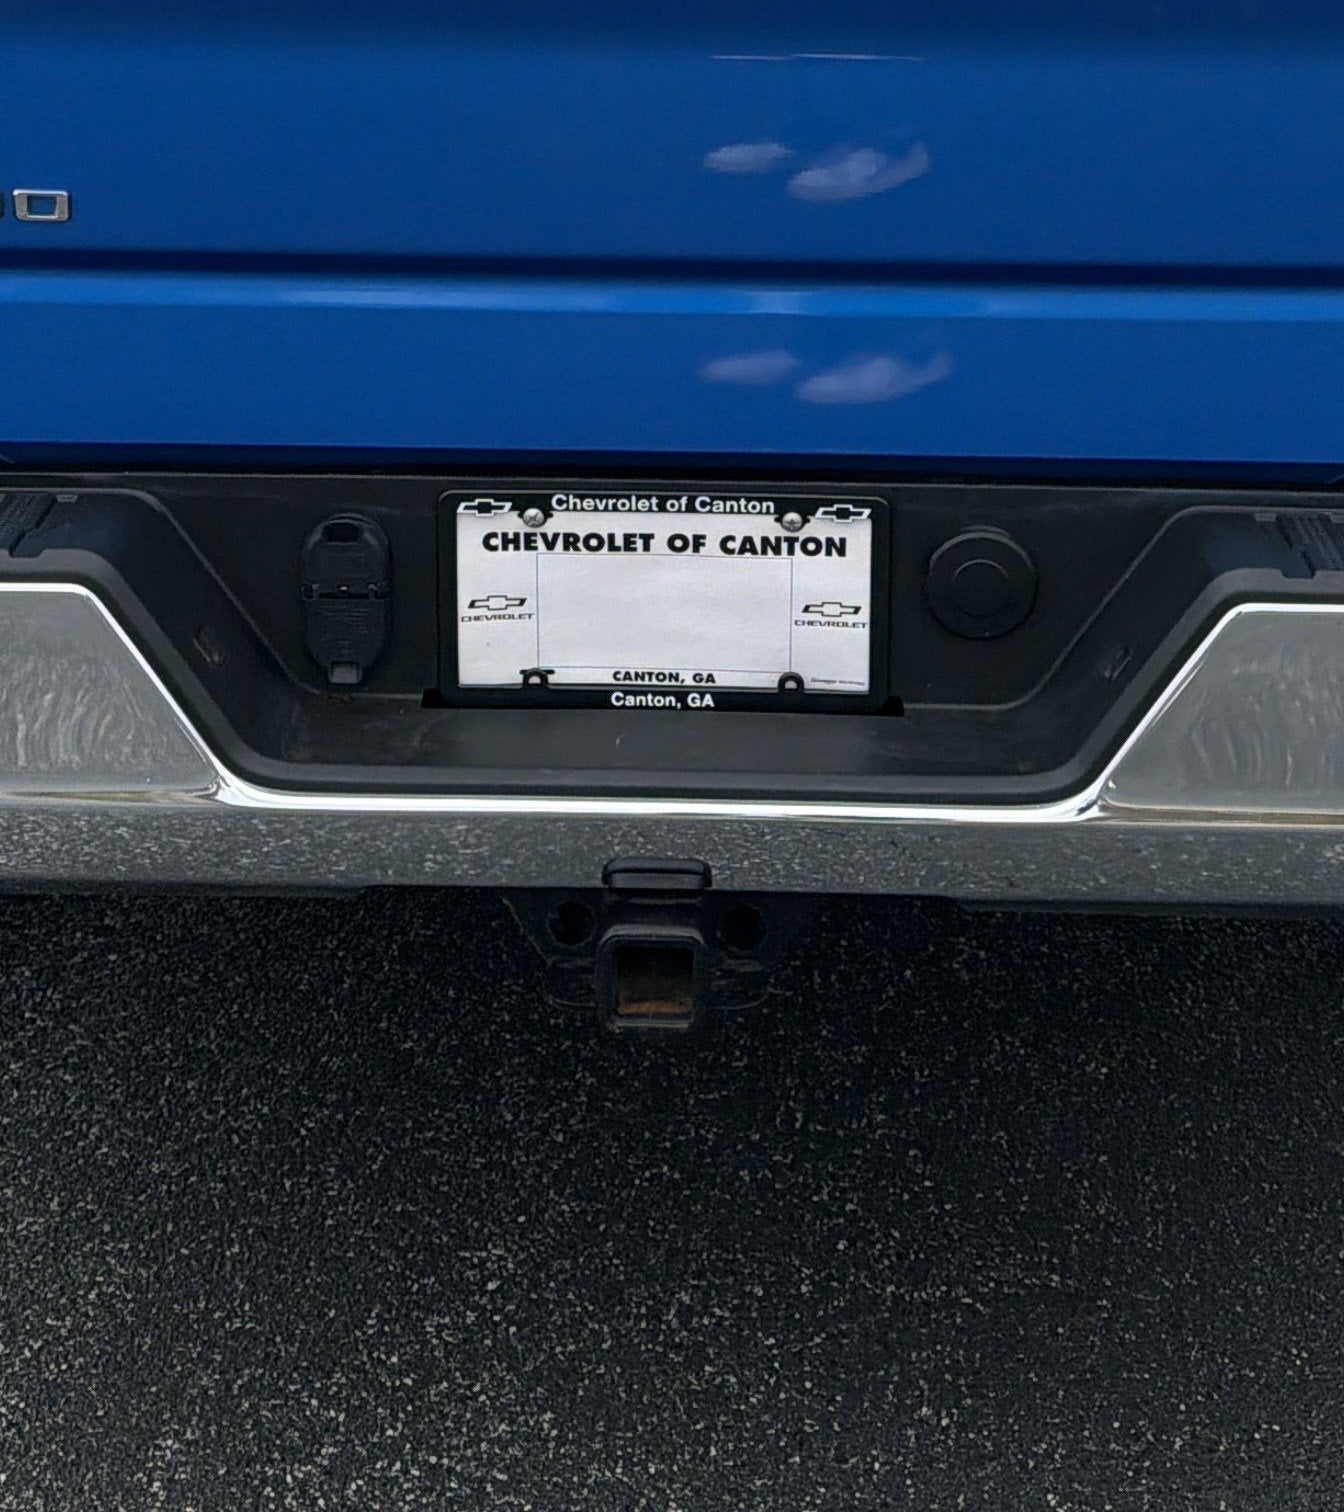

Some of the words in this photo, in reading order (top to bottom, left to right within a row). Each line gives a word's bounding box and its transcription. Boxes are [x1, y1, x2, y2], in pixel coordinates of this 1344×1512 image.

[551, 495, 658, 513] Chevrolet
[665, 497, 687, 513] of
[690, 497, 775, 514] Canton
[481, 532, 655, 553] CHEVROLET
[667, 534, 707, 554] OF
[719, 535, 847, 558] CANTON
[461, 613, 534, 623] CHEVROLET
[794, 619, 867, 629] CHEVROLET
[612, 670, 686, 685] CANTON,
[692, 672, 716, 685] GA
[611, 692, 683, 711] Canton,
[687, 694, 714, 709] GA
